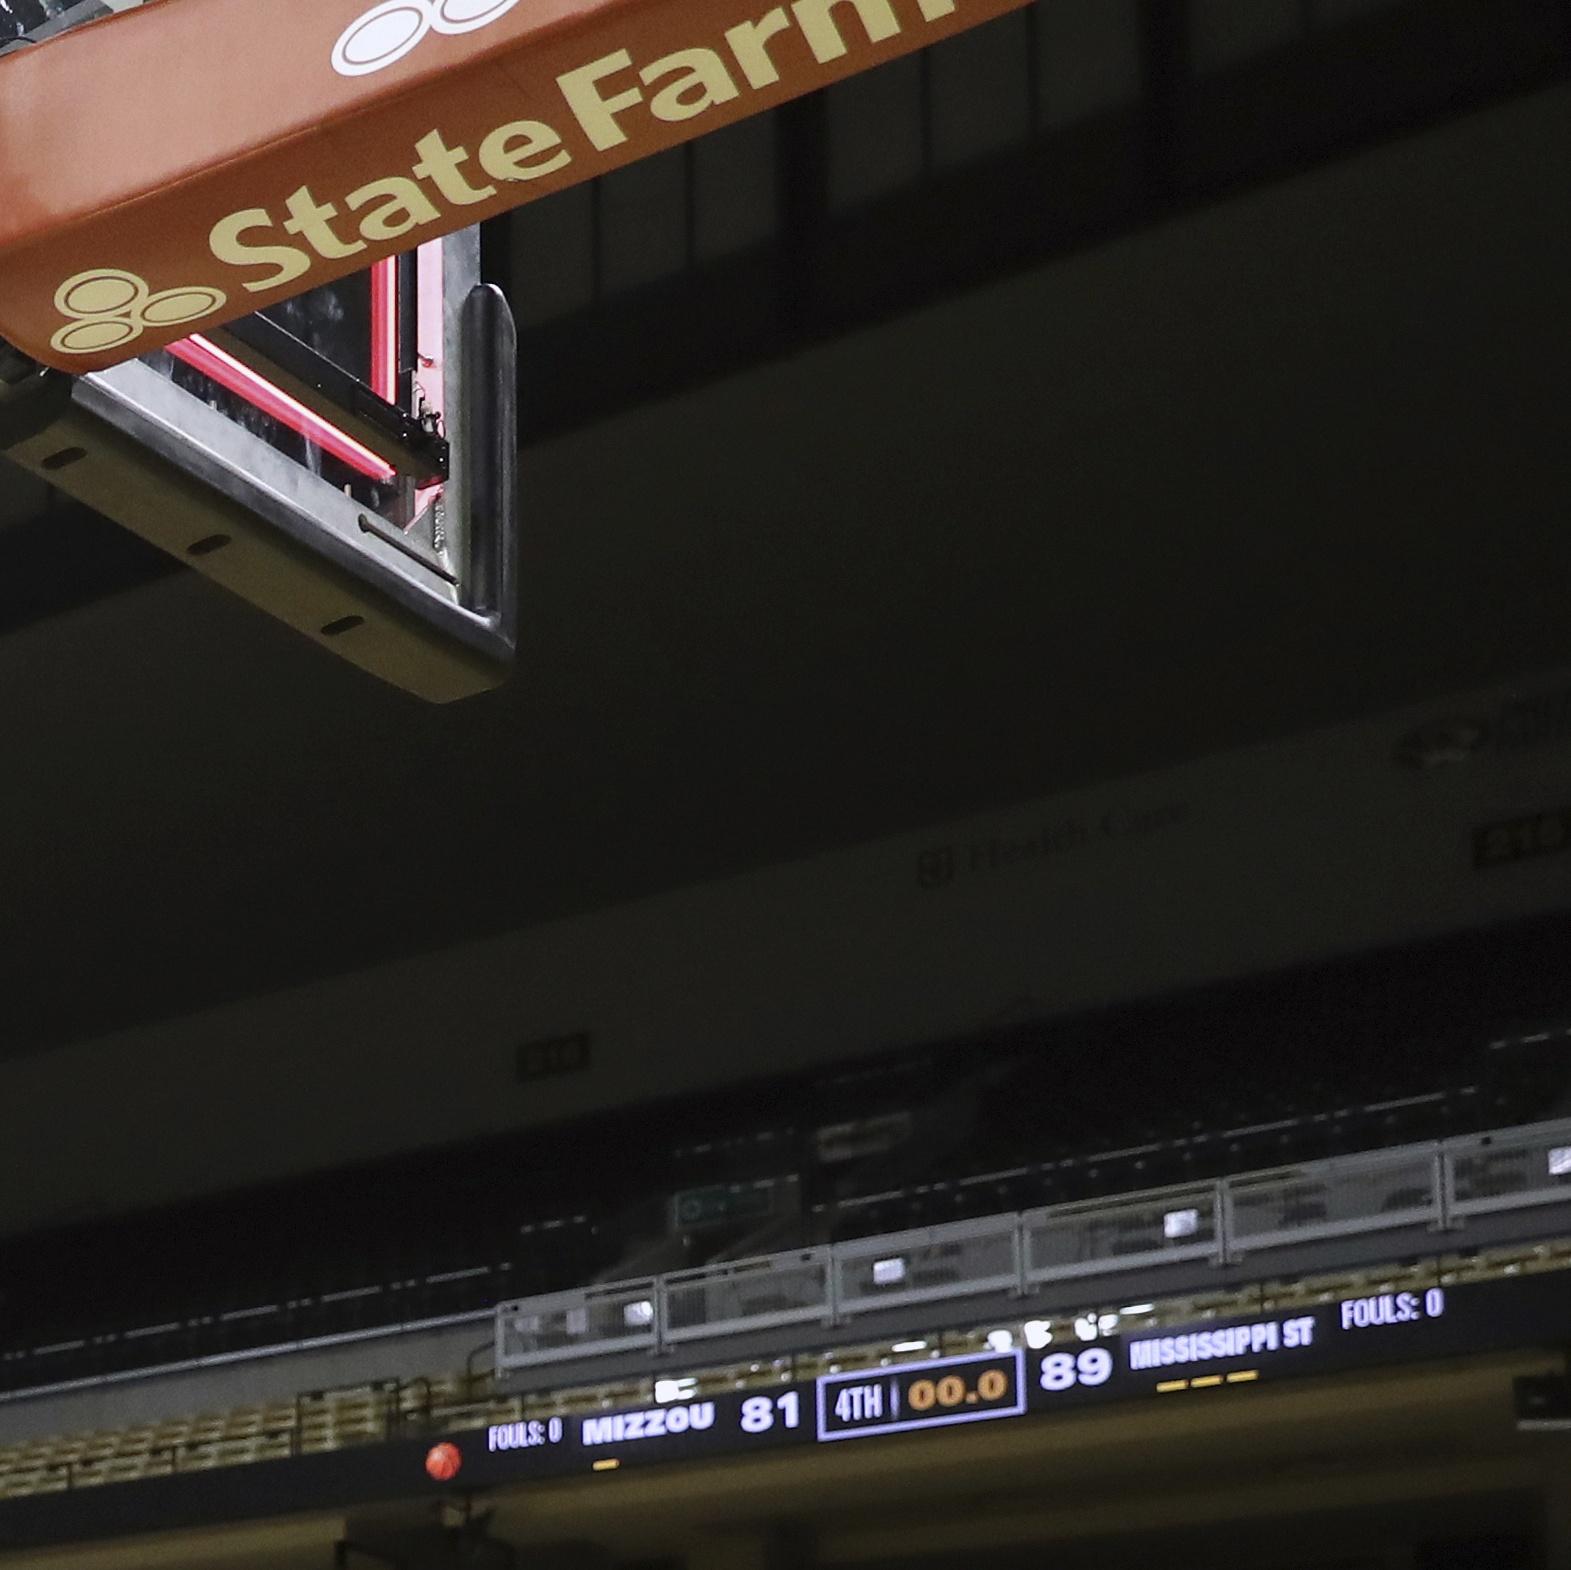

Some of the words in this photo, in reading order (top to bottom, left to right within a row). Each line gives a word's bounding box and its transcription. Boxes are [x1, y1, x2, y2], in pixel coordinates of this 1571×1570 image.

[488, 1420, 545, 1452] FOULS:
[548, 1416, 562, 1443] 0
[582, 1402, 716, 1446] MIZZOU
[740, 1390, 800, 1434] 81
[834, 1384, 884, 1423] 4TH
[908, 1369, 1008, 1412] 00.0
[1039, 1347, 1114, 1391] 89
[1128, 1321, 1279, 1371] MISSISSIPPI
[1283, 1315, 1316, 1349] ST
[1341, 1290, 1420, 1330] FOULS:
[1425, 1287, 1445, 1318] 0
